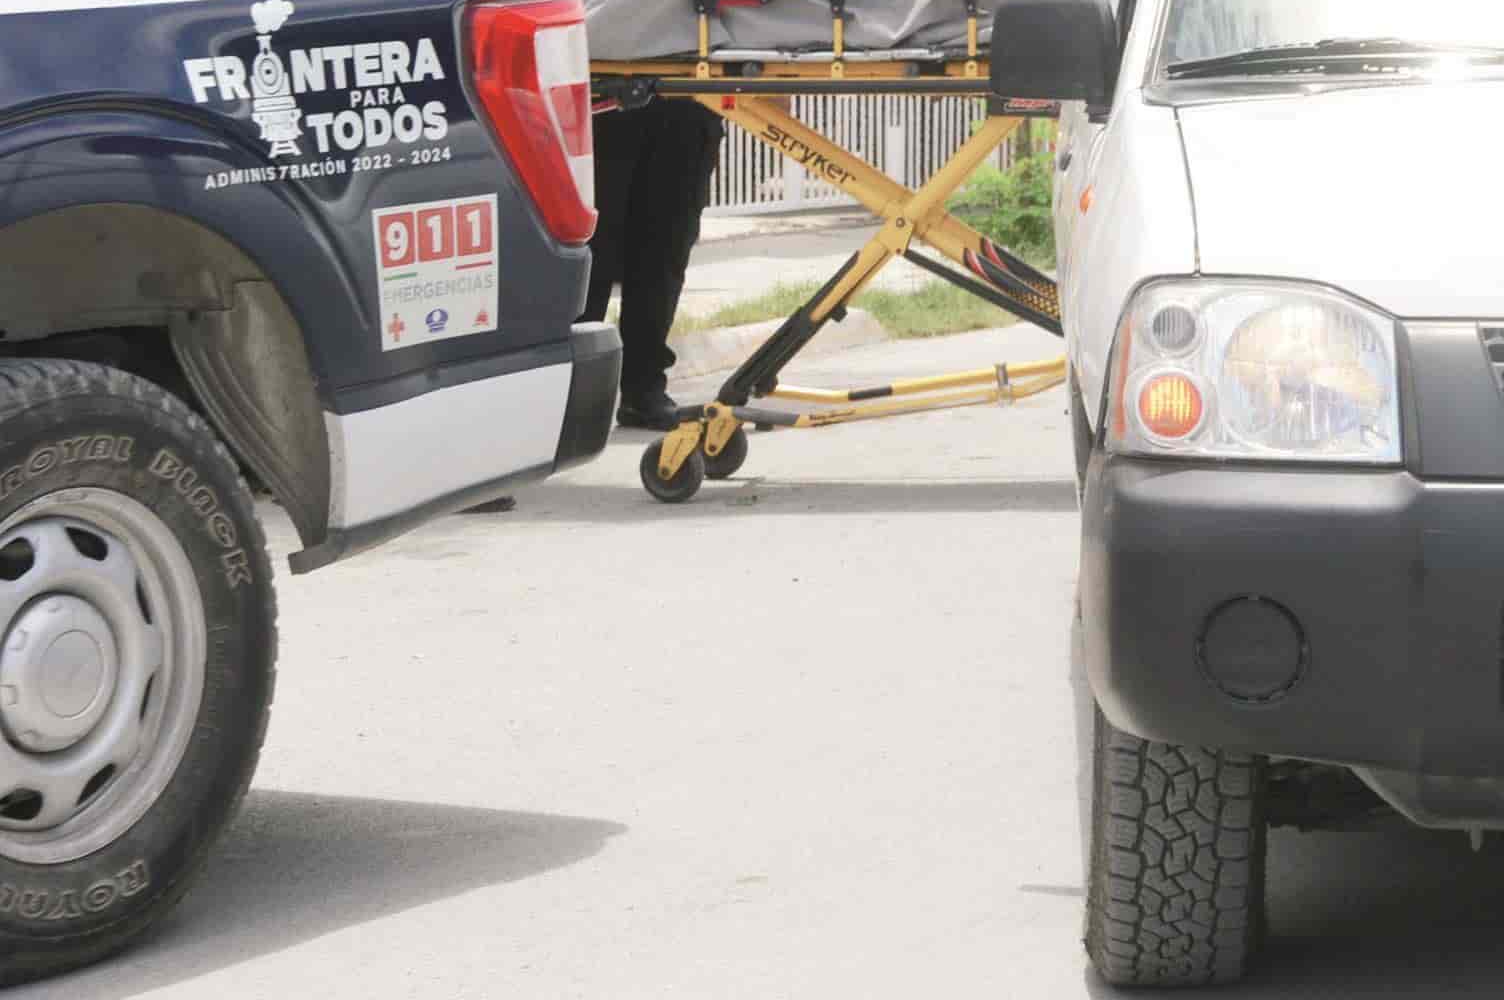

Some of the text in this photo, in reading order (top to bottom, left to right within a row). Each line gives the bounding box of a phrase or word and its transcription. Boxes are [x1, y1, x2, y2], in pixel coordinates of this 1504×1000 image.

[184, 38, 445, 104] FRONTERA
[350, 86, 406, 108] PARA
[306, 101, 449, 153] TODOS
[204, 156, 347, 190] ADMINISTRACIÓN
[351, 153, 393, 173] 2022
[411, 146, 452, 165] 2024
[385, 208, 482, 262] 911
